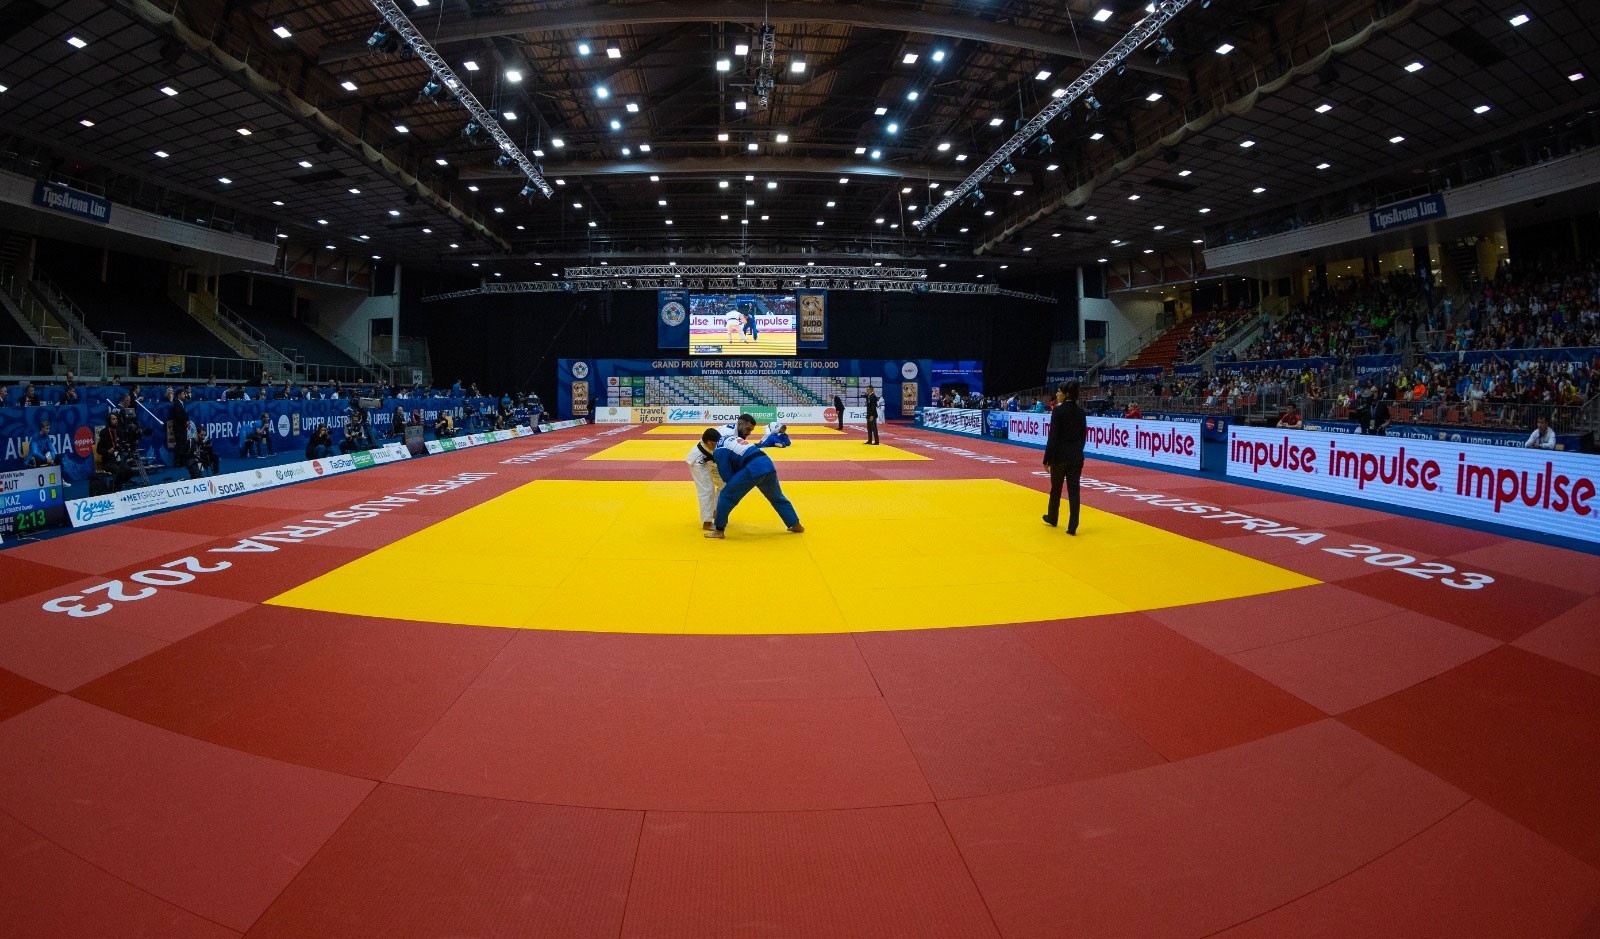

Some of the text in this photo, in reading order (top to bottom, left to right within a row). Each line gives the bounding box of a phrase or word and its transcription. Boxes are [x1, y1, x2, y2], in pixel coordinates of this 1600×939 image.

[42, 186, 107, 218] TipsArena Linz
[1374, 201, 1438, 228] TipsArena Linz
[756, 316, 789, 327] mpulse
[373, 412, 390, 425] UPPER
[640, 415, 664, 423] ijf.org
[1009, 415, 1038, 437] impulse
[5, 433, 73, 460] AURIA
[1086, 423, 1195, 457] mpulse impulse
[329, 458, 354, 470] TaiShan
[4, 474, 45, 490] AUT 0
[1231, 433, 1596, 517] impulse impulse impulse
[4, 489, 46, 507] KAZ 0
[193, 483, 207, 494] AG
[218, 481, 246, 495] SOCAR
[16, 509, 46, 530] 2:13
[42, 472, 498, 618] UPPER AUSTRIA 2023
[1118, 494, 1327, 546] AUSTRIA
[1321, 544, 1496, 590] 2023
